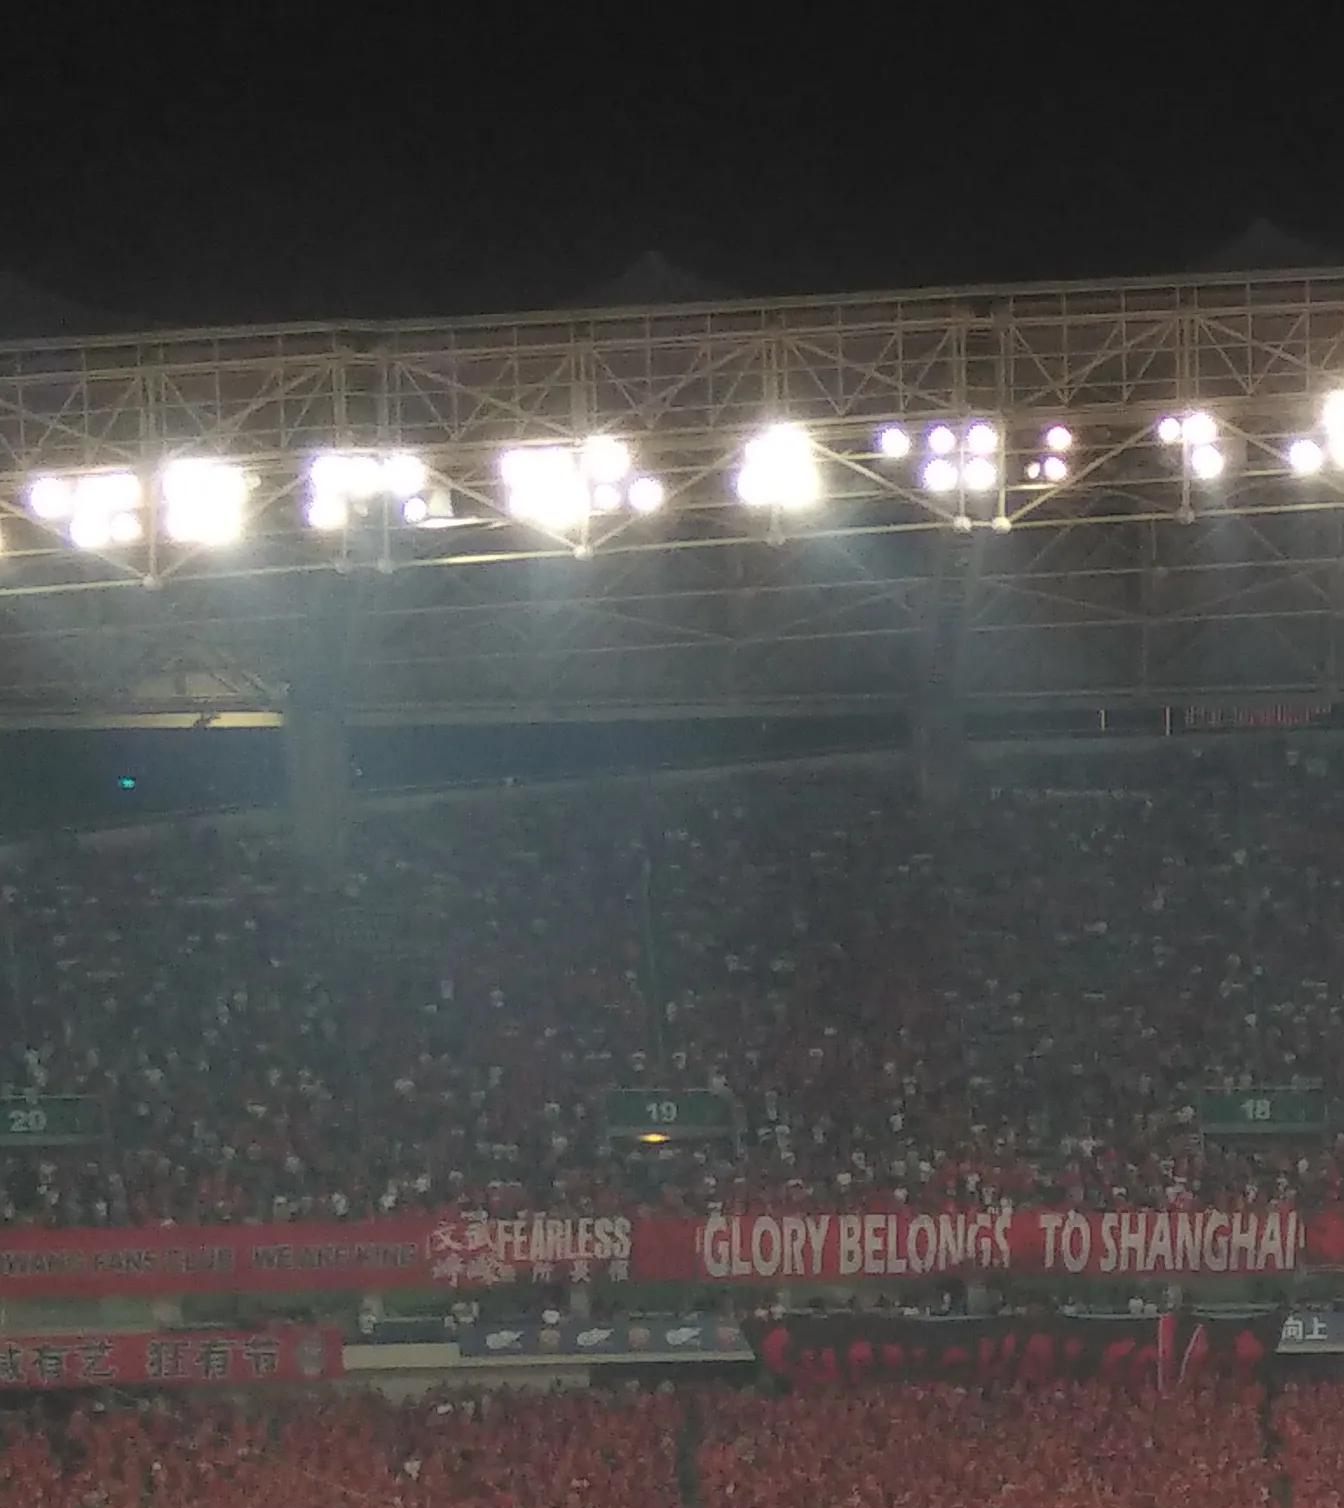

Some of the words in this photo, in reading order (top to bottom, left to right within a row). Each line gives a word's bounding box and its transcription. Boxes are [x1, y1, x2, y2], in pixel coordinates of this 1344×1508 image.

[647, 1103, 677, 1122] 19
[1241, 1100, 1271, 1119] 18
[497, 1216, 632, 1260] FEARLESS
[703, 1212, 828, 1277] GLORY
[838, 1211, 1012, 1274] BELONGS
[1040, 1212, 1092, 1272] TO
[1099, 1211, 1297, 1272] SHANGHAI
